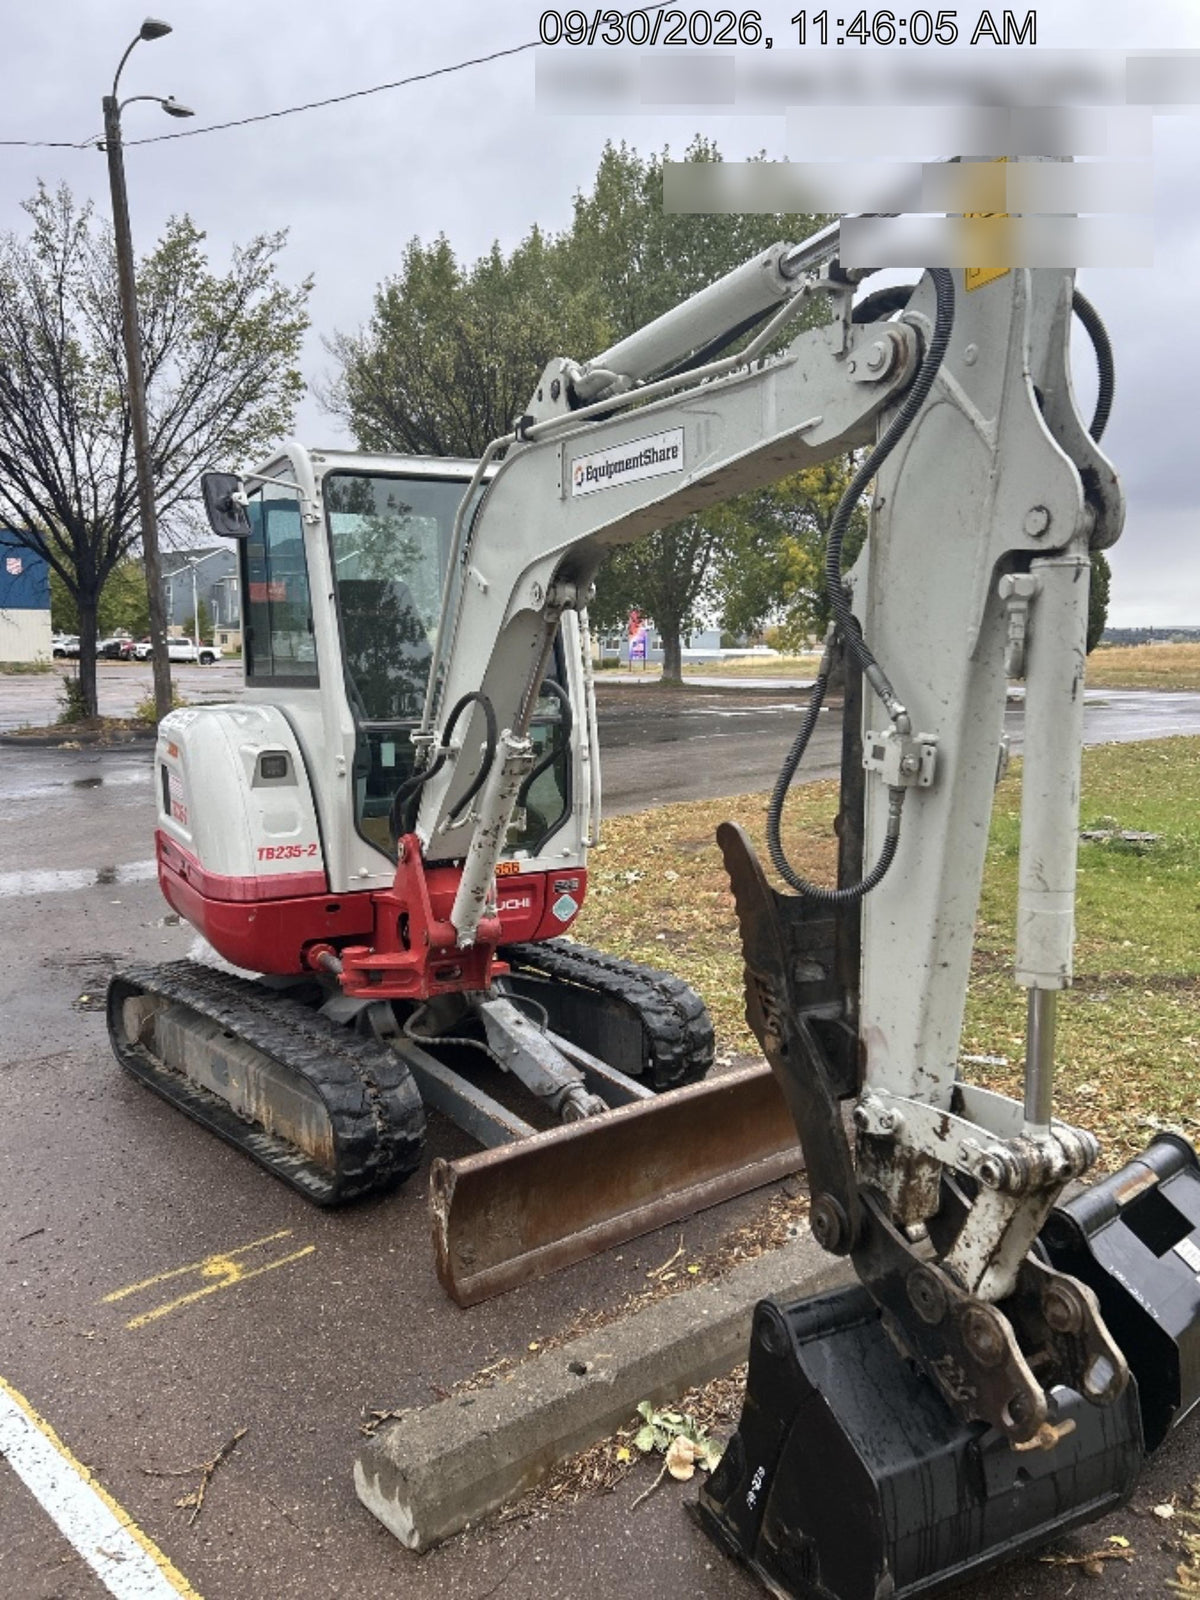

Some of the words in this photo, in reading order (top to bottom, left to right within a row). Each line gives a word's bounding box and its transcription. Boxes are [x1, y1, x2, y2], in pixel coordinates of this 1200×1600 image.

[586, 445, 679, 482] EquipmentShare
[257, 843, 318, 861] TB235-2
[495, 897, 531, 911] UCHI
